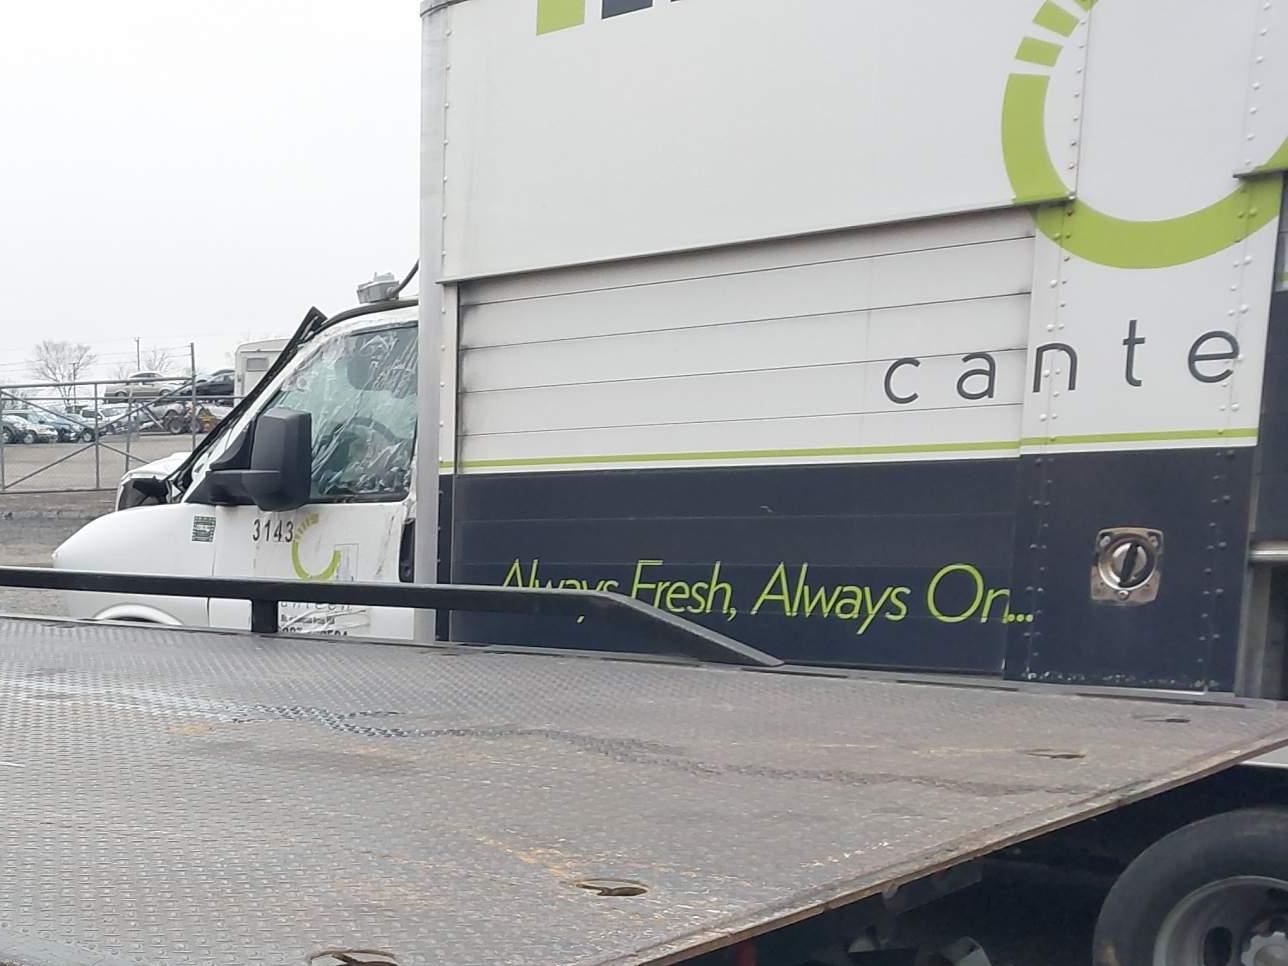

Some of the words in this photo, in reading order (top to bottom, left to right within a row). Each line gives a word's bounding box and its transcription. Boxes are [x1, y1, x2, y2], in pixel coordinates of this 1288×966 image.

[253, 519, 293, 542] 3143
[632, 559, 736, 621] Fresh,
[751, 561, 911, 634] Always
